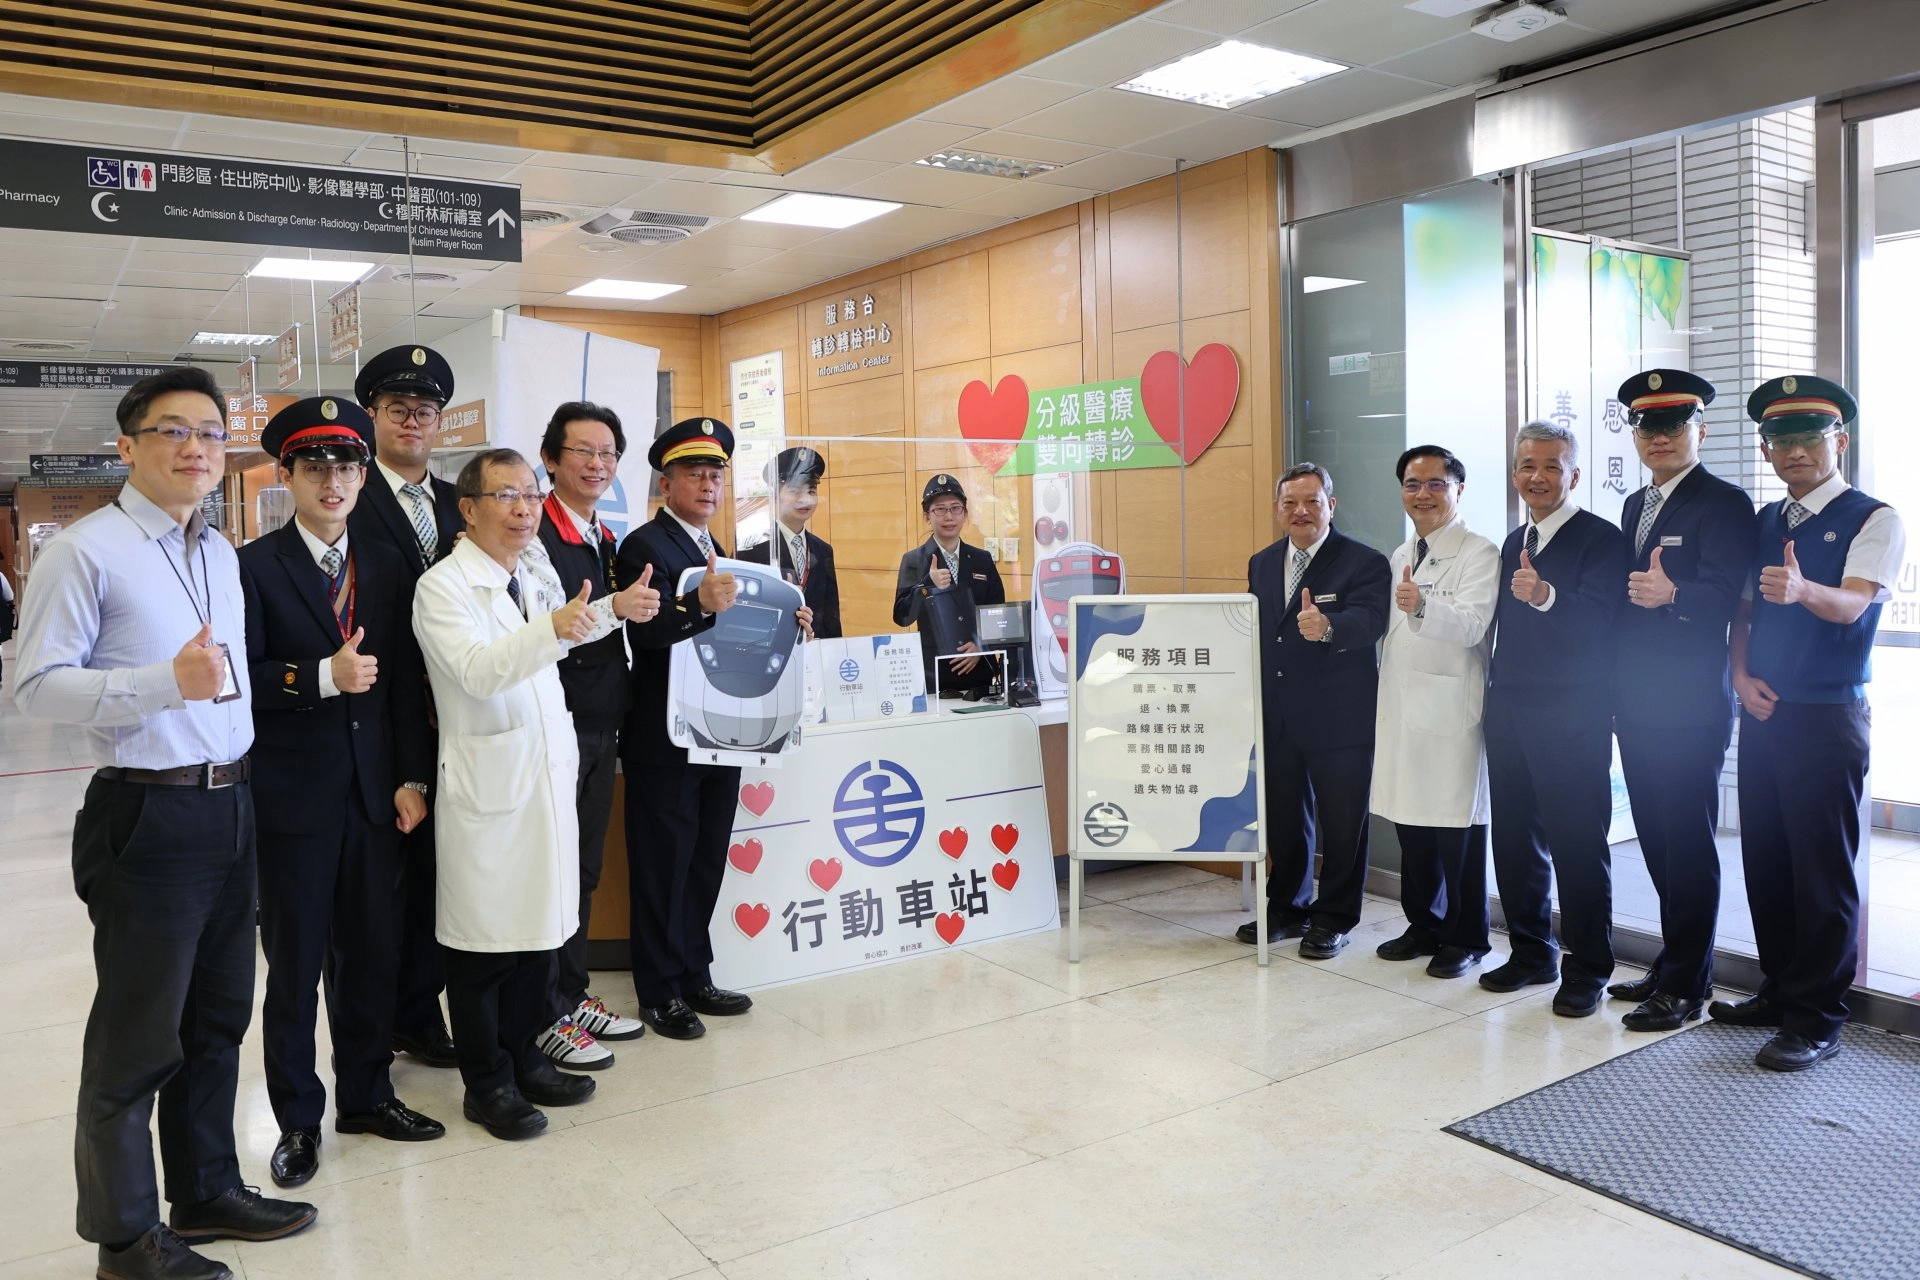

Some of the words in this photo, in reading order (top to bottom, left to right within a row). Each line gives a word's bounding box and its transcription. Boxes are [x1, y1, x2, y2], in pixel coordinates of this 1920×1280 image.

[238, 211, 245, 221] &
[247, 211, 288, 226] Discharge
[418, 225, 448, 237] Chinese
[450, 227, 483, 239] Medicine
[436, 238, 460, 251] Prayer
[461, 240, 483, 251] Room
[825, 294, 875, 325] 服務台
[812, 322, 892, 359] 轉診轉檢中心
[817, 361, 859, 377] Information
[862, 355, 891, 368] Center
[1035, 386, 1134, 430] 分級醫療
[1036, 426, 1135, 467] 雙向轉診
[1117, 648, 1210, 666] 服務項目
[1126, 723, 1205, 734] 路線運行狀況
[1141, 763, 1192, 774] 愛心通報
[782, 869, 989, 952] 行動車站
